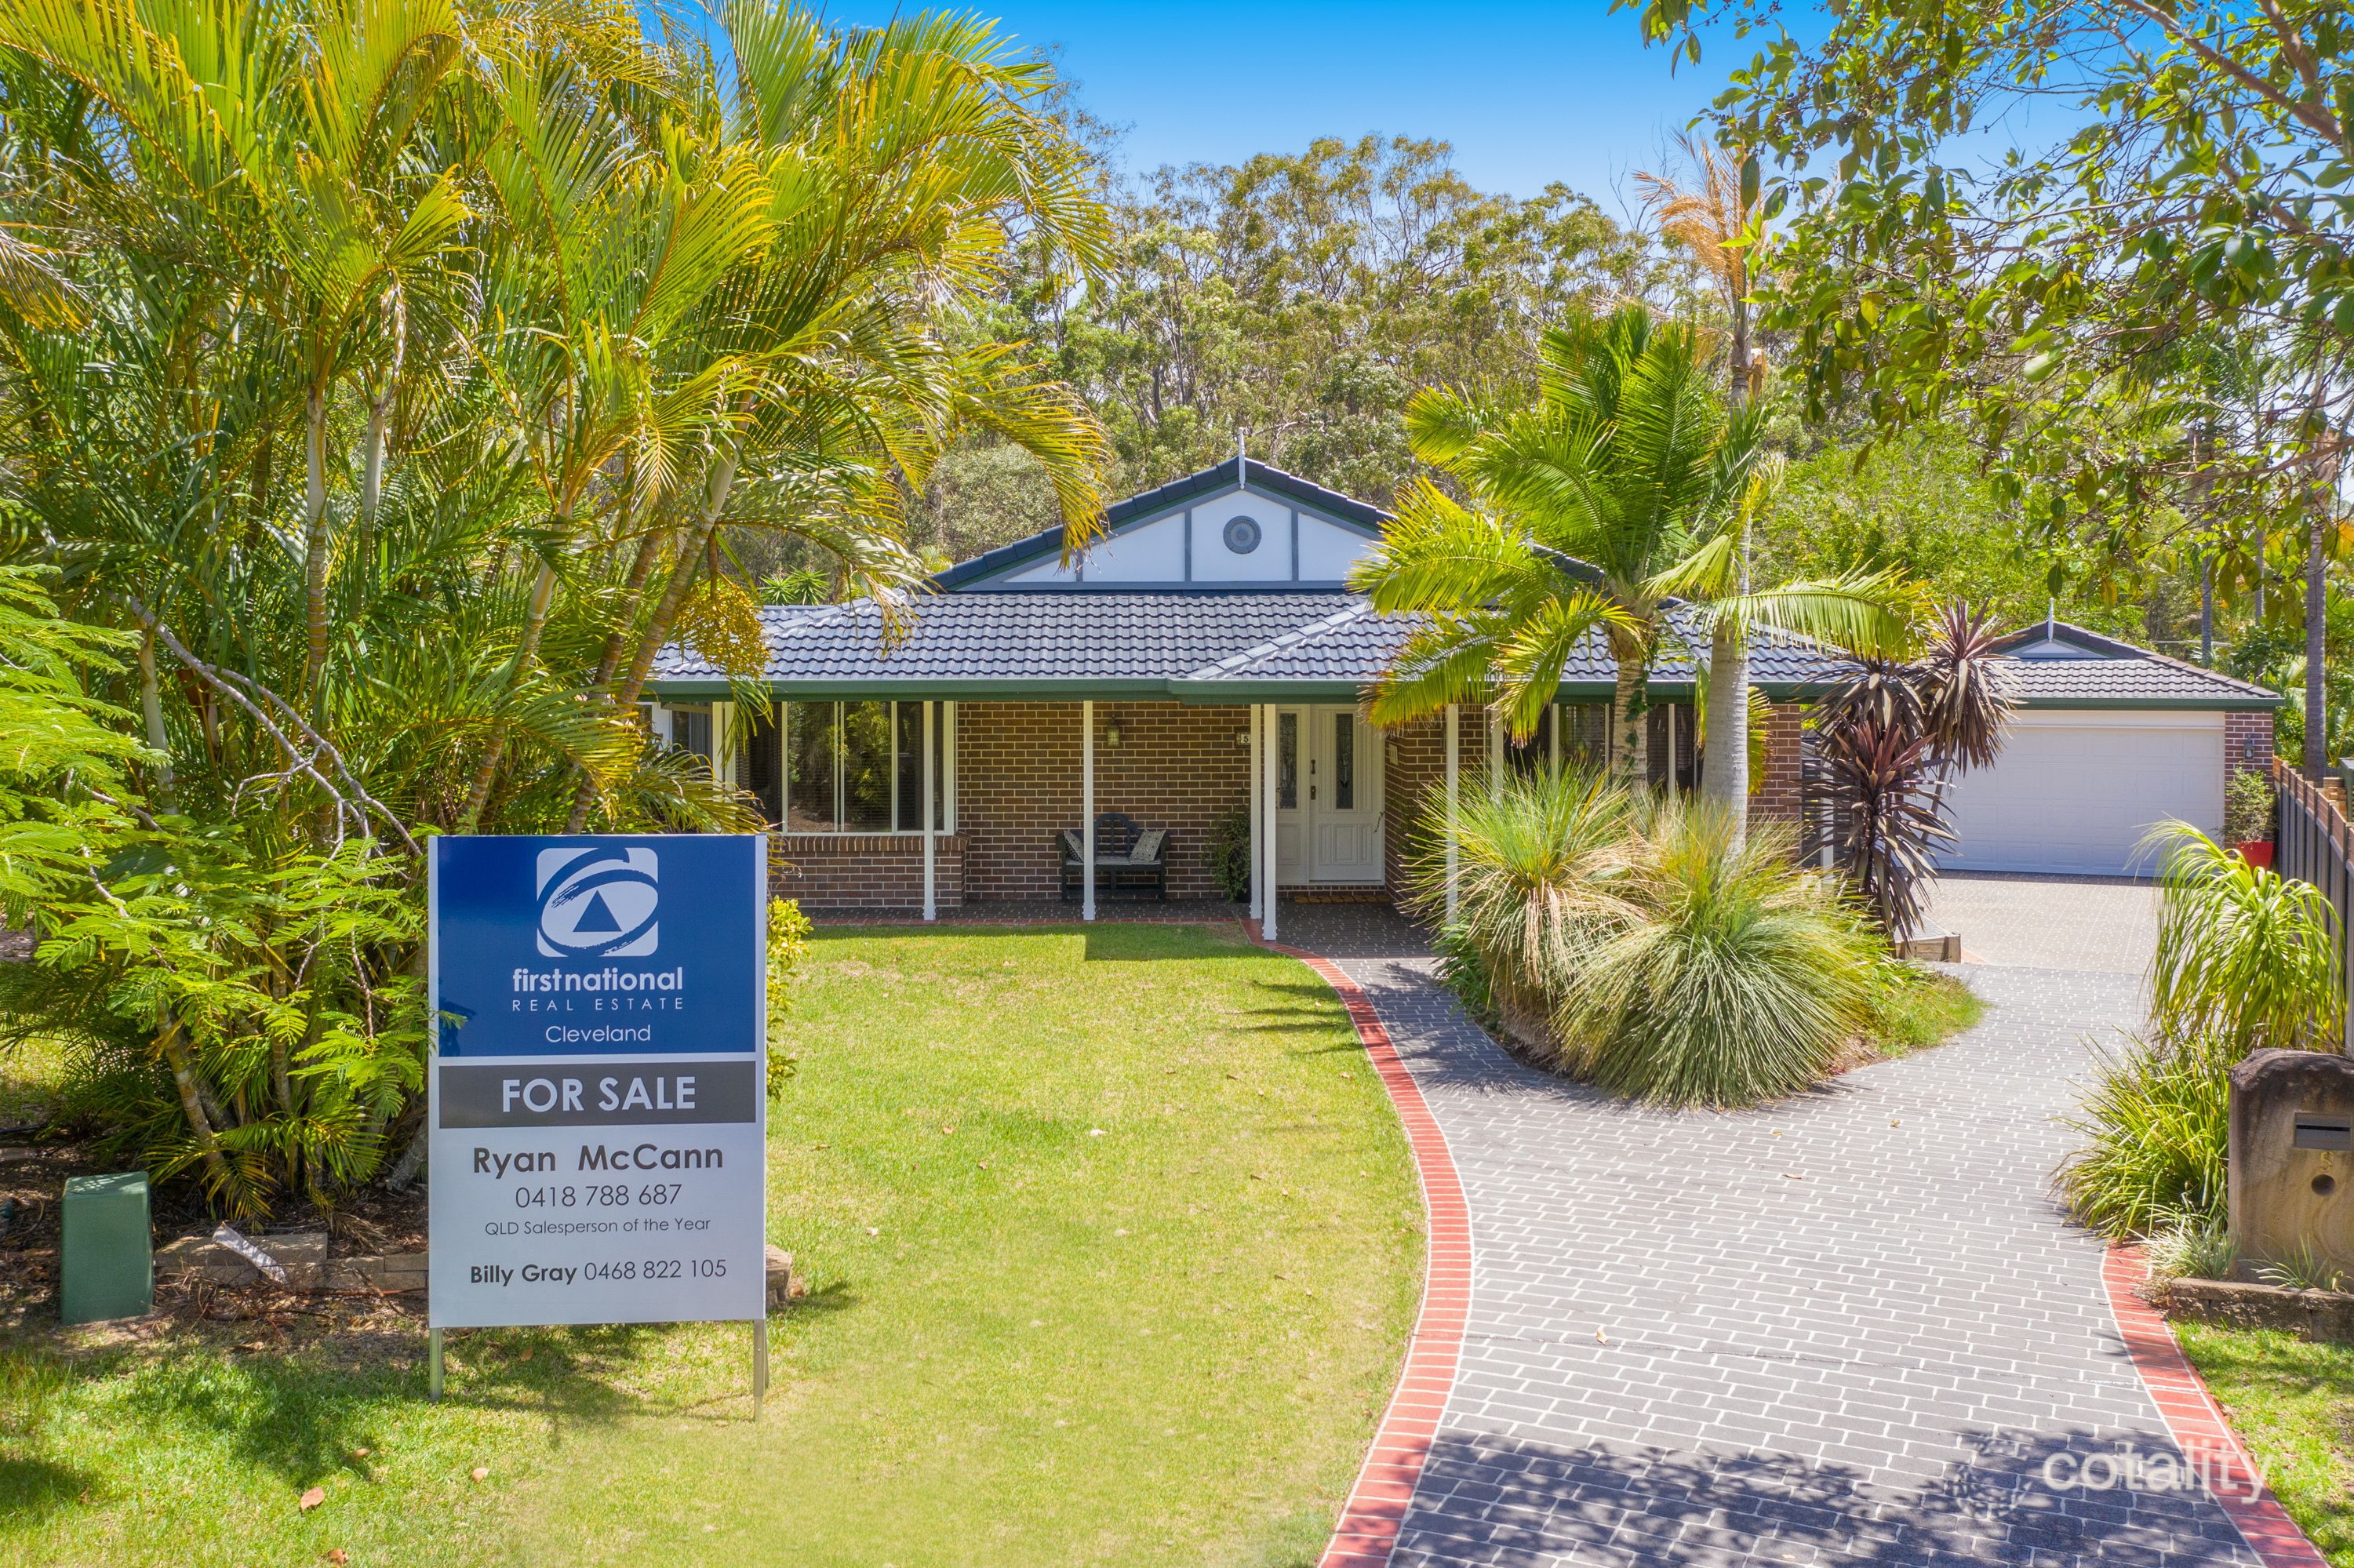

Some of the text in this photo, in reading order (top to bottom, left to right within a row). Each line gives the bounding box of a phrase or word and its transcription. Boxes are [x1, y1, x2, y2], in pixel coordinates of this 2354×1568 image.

[512, 997, 683, 1012] REAL ESTATE
[545, 1024, 651, 1043] Cleveland
[502, 1076, 696, 1113] FOR SALE
[473, 1143, 723, 1180] Ryan McCann
[515, 1184, 682, 1209] 0418 788 687
[485, 1217, 711, 1237] QLD Salesperson of the Year
[471, 1259, 726, 1287] Billy Gray 0468 822 105
